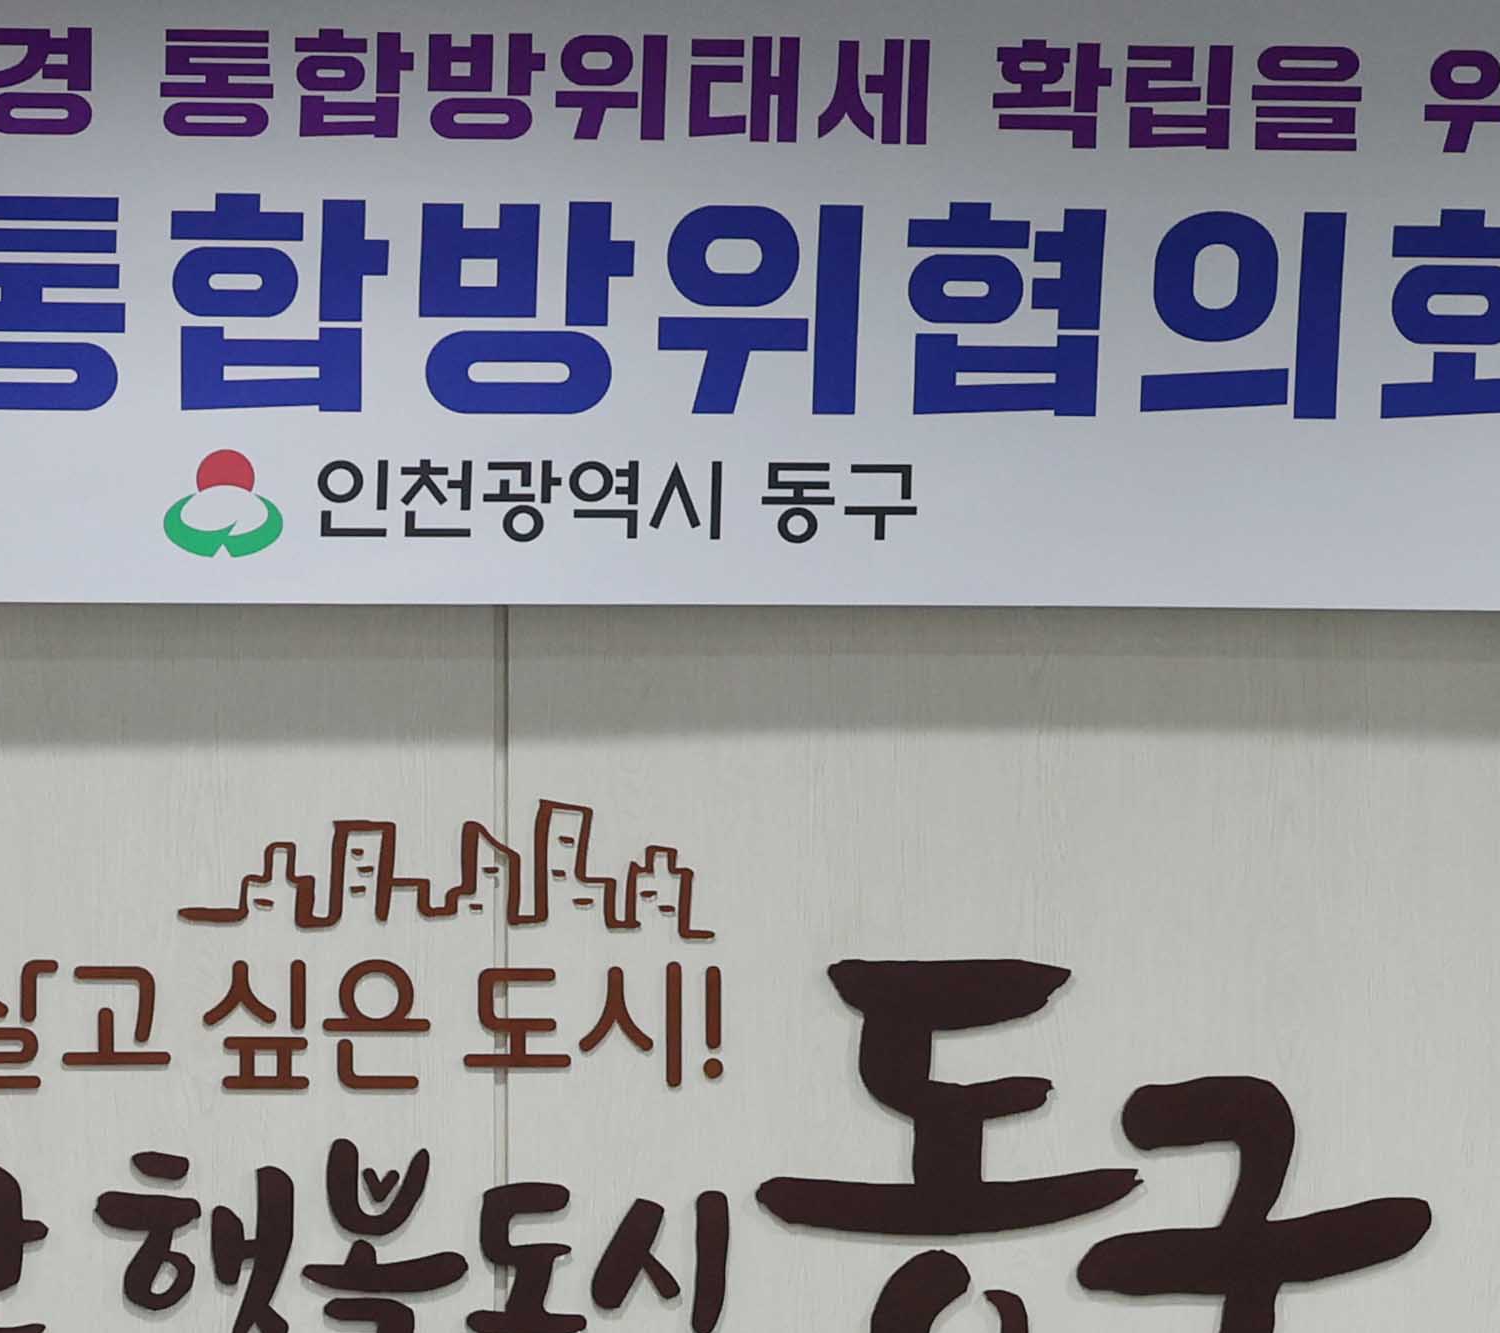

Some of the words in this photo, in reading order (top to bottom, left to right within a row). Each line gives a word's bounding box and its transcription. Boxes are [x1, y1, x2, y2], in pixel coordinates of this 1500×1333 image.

[159, 28, 931, 145] 통합방위태세
[992, 38, 1363, 152] 확립을
[316, 459, 723, 543] 인천광역시
[761, 462, 919, 544] 동구
[201, 957, 432, 1091] 싶은
[462, 959, 724, 1089] 도시!
